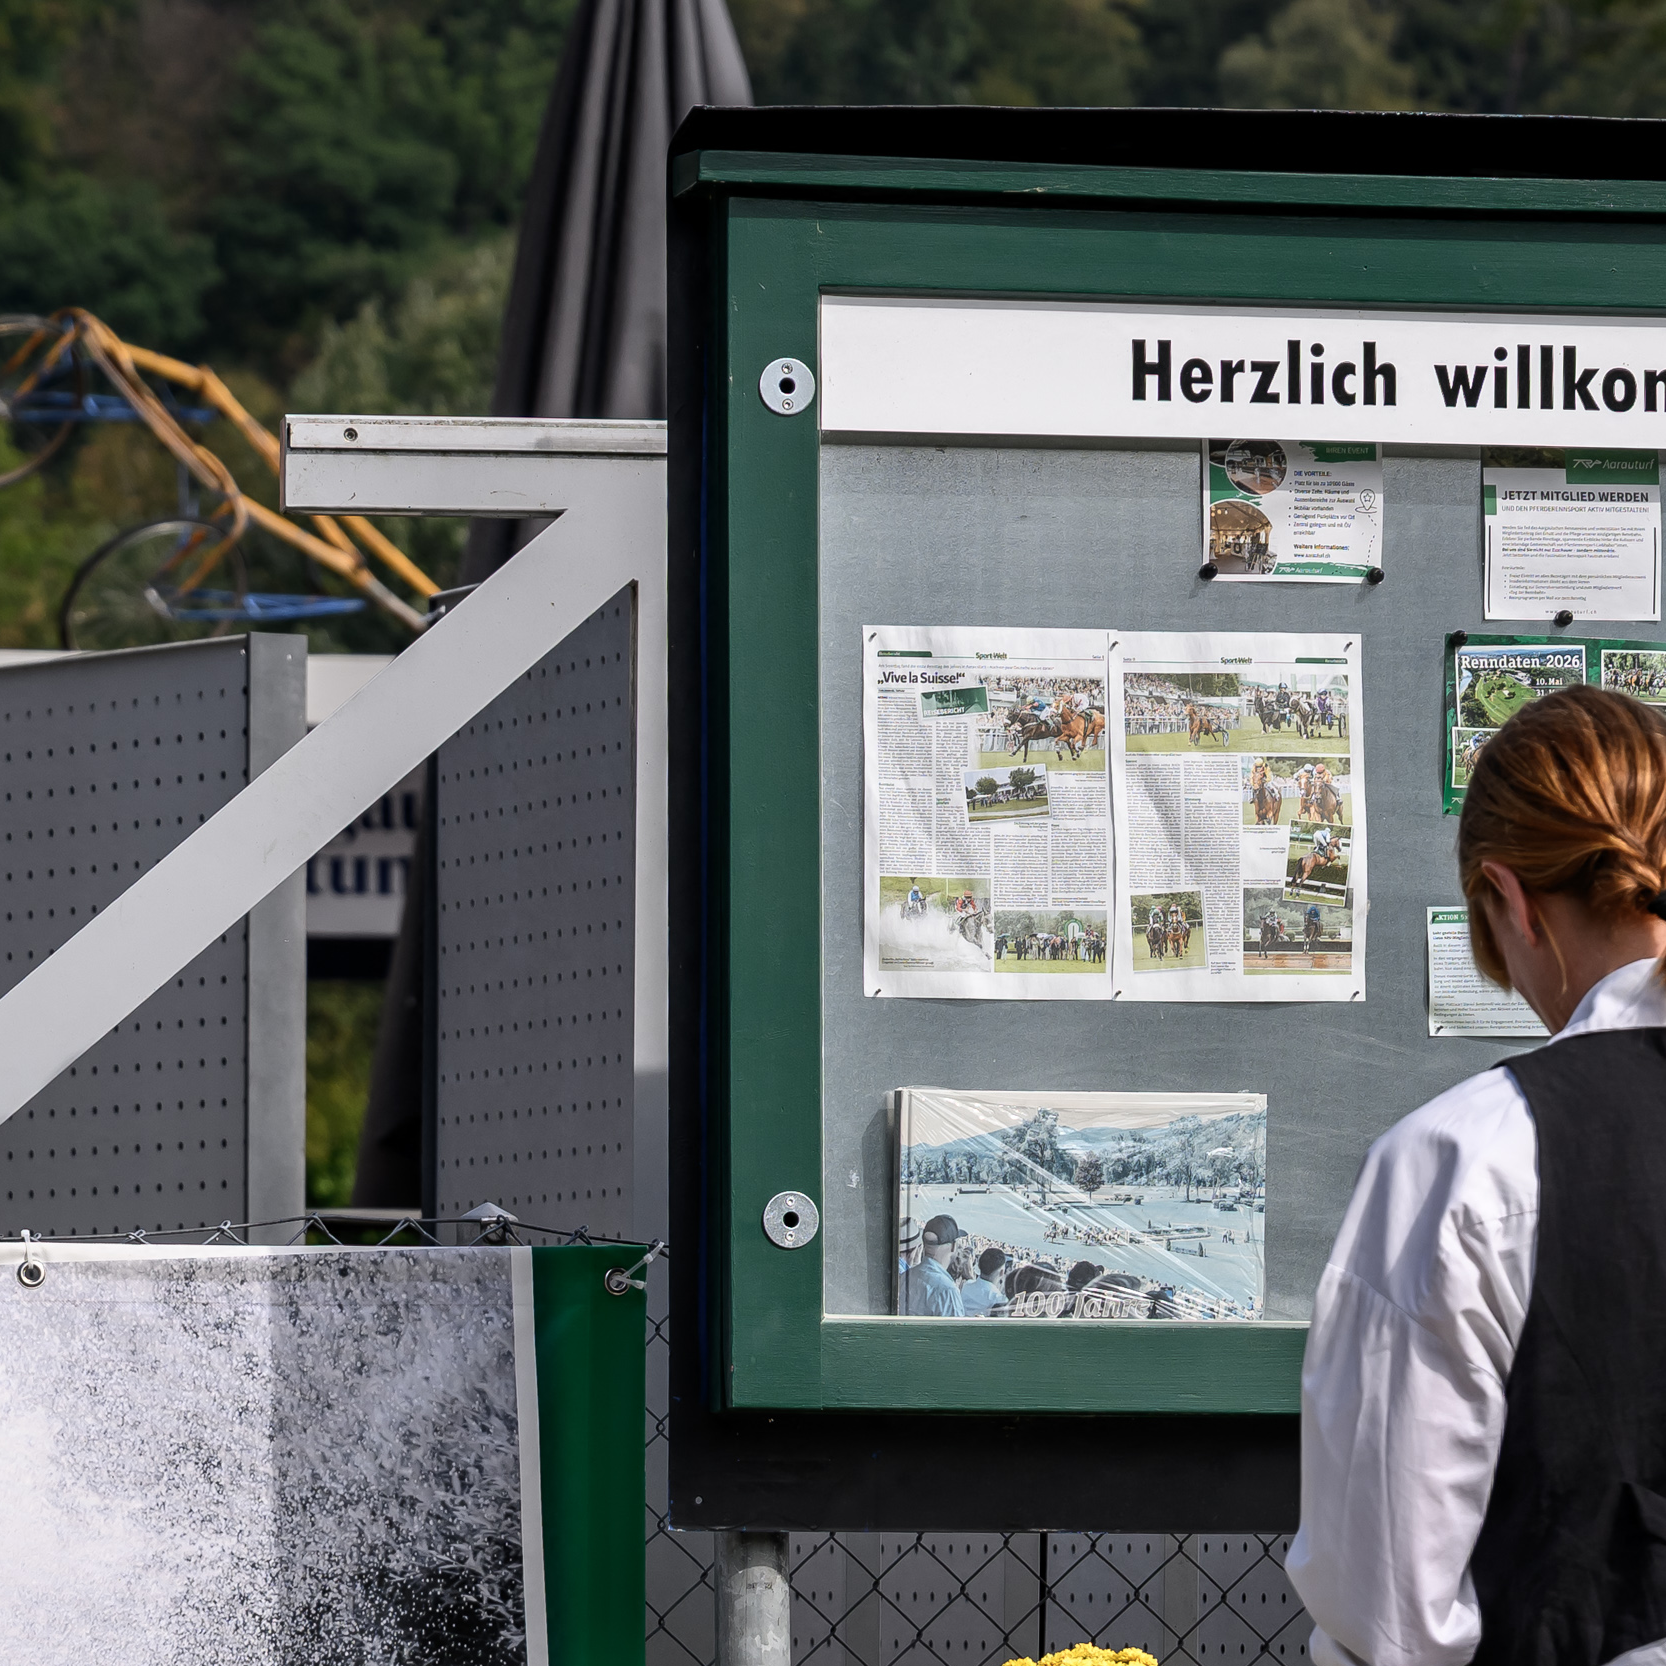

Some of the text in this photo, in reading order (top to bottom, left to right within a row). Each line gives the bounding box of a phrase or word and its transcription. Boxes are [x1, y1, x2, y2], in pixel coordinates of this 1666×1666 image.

[1132, 338, 1397, 406] Herzlich
[1602, 459, 1655, 470] Aarauturf
[1501, 490, 1649, 503] JETZT MITGLIED WERDEN
[1460, 654, 1580, 669] Renndaten 2026
[908, 672, 918, 683] la
[1536, 678, 1563, 686] 10. Mai
[1011, 1291, 1153, 1319] 100 Jahre
